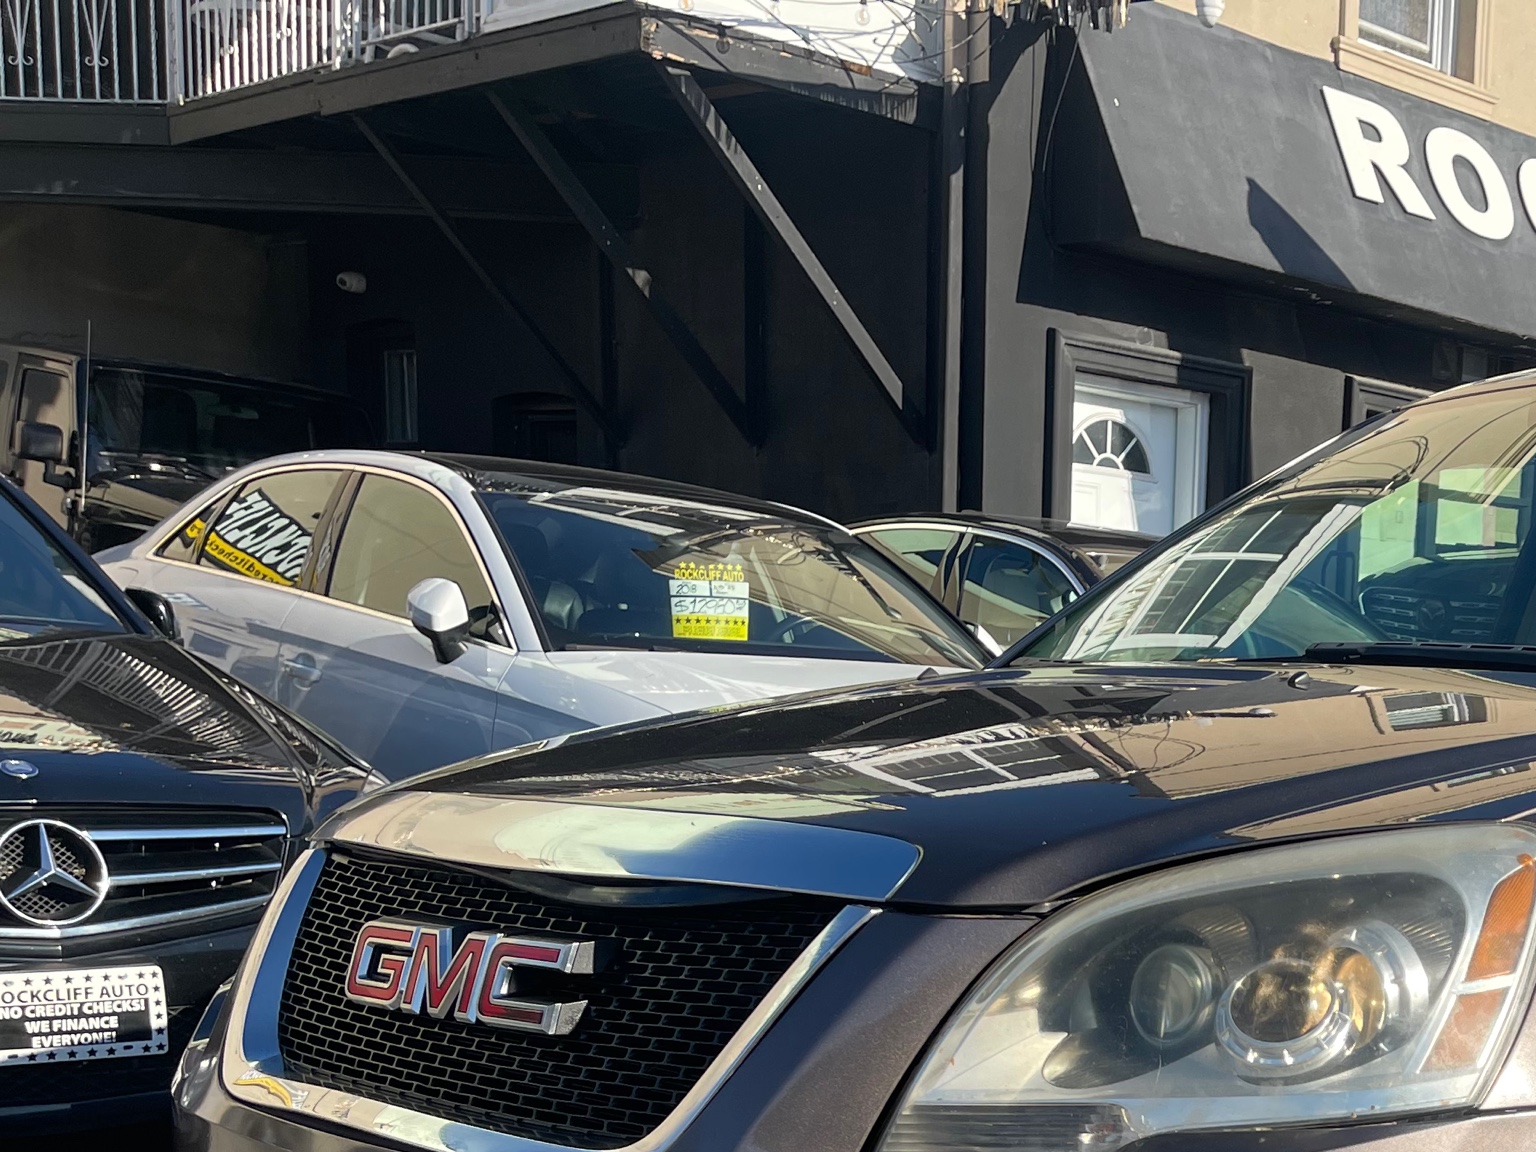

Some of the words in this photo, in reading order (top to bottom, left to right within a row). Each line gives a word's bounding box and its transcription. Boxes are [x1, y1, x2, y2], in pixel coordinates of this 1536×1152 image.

[674, 568, 721, 580] ROCKCLIFF
[722, 571, 745, 582] AUTO
[345, 920, 595, 1036] GMC
[0, 986, 94, 1004] OCKCLIFF
[99, 983, 149, 998] AUTO
[0, 1006, 23, 1020] NO
[24, 1002, 81, 1018] CREDIT
[82, 999, 146, 1014] CHECKS!
[24, 1019, 50, 1034] WE
[52, 1016, 119, 1032] FINANCE
[31, 1031, 117, 1049] EVERYONE!
